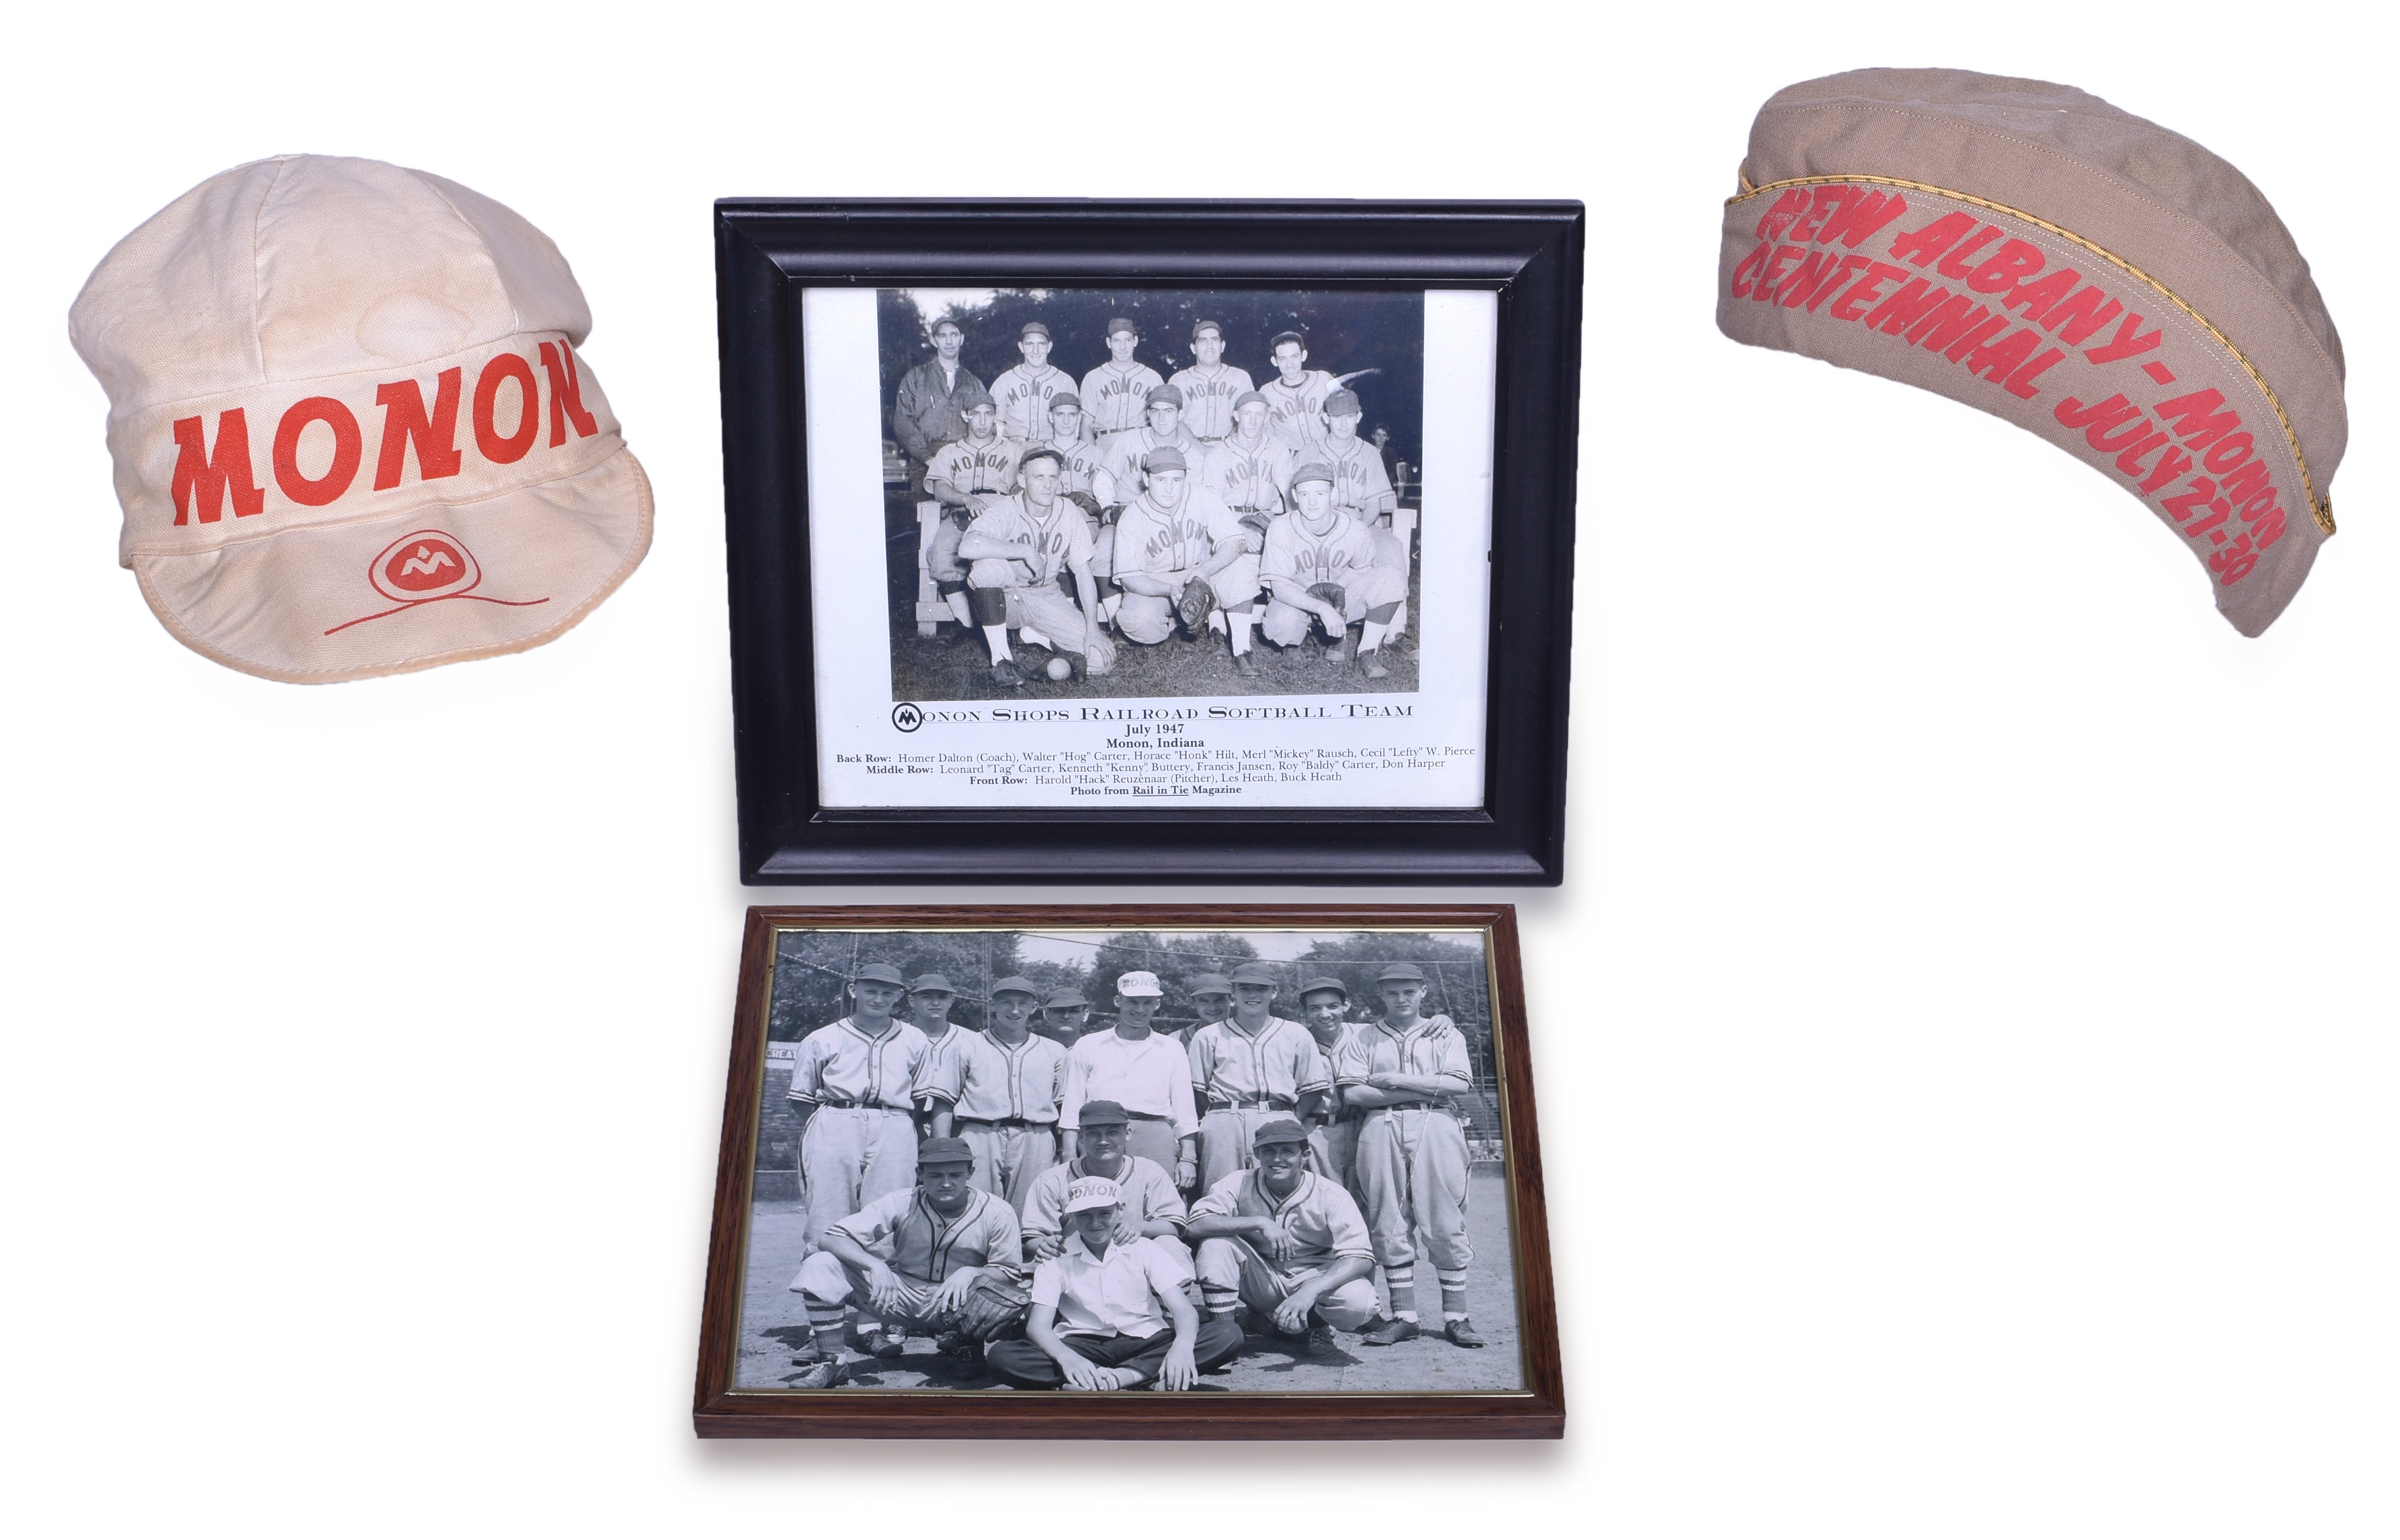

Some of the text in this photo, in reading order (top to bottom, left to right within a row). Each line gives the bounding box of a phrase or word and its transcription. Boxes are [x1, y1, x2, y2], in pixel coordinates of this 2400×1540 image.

[1756, 185, 1907, 249] NEW
[2153, 387, 2288, 551] MONON
[1007, 379, 1053, 406] MONO
[1186, 380, 1238, 401] MONON
[1732, 241, 2260, 587] CENTENNIAL JULY 27-30
[171, 338, 598, 526] MONON
[951, 452, 1009, 477] MONON
[1125, 724, 1184, 736] July 1947
[1106, 738, 1204, 749] Monon, Indiana
[837, 754, 862, 762] Back
[866, 754, 891, 762] Row:
[899, 754, 935, 762] Homer
[939, 754, 973, 762] Dalton
[977, 753, 1019, 763] (Coach),
[1023, 752, 1057, 761] Walter
[1094, 752, 1130, 761] Carter,
[1134, 751, 1171, 759] Horace
[1215, 751, 1238, 759] Hilt,
[1242, 750, 1266, 759] Merl
[1317, 749, 1357, 758] Rausch,
[1361, 748, 1385, 757] Cecil
[1426, 747, 1440, 755] W.
[1444, 746, 1475, 755] Pierce
[940, 765, 984, 774] Leonard
[1019, 764, 1055, 774] Carter,
[1059, 764, 1102, 772] Kenneth
[1152, 763, 1193, 774] Buttery,
[1197, 762, 1234, 771] Francis
[1236, 762, 1274, 773] Jansen,
[1279, 762, 1298, 772] Roy
[1342, 761, 1378, 769] Carter,
[1382, 759, 1403, 768] Don
[1407, 759, 1446, 770] Harper
[970, 776, 998, 785] Front
[1035, 776, 1071, 784] Harold
[1171, 774, 1218, 784] (Pitcher),
[1221, 774, 1238, 782] Les
[1243, 773, 1277, 782] Heath,
[1281, 772, 1307, 782] Buck
[1311, 772, 1342, 781] Heath
[1070, 786, 1100, 795] Photo
[1105, 786, 1128, 795] from
[1158, 786, 1167, 794] in
[1192, 785, 1242, 796] Magazine
